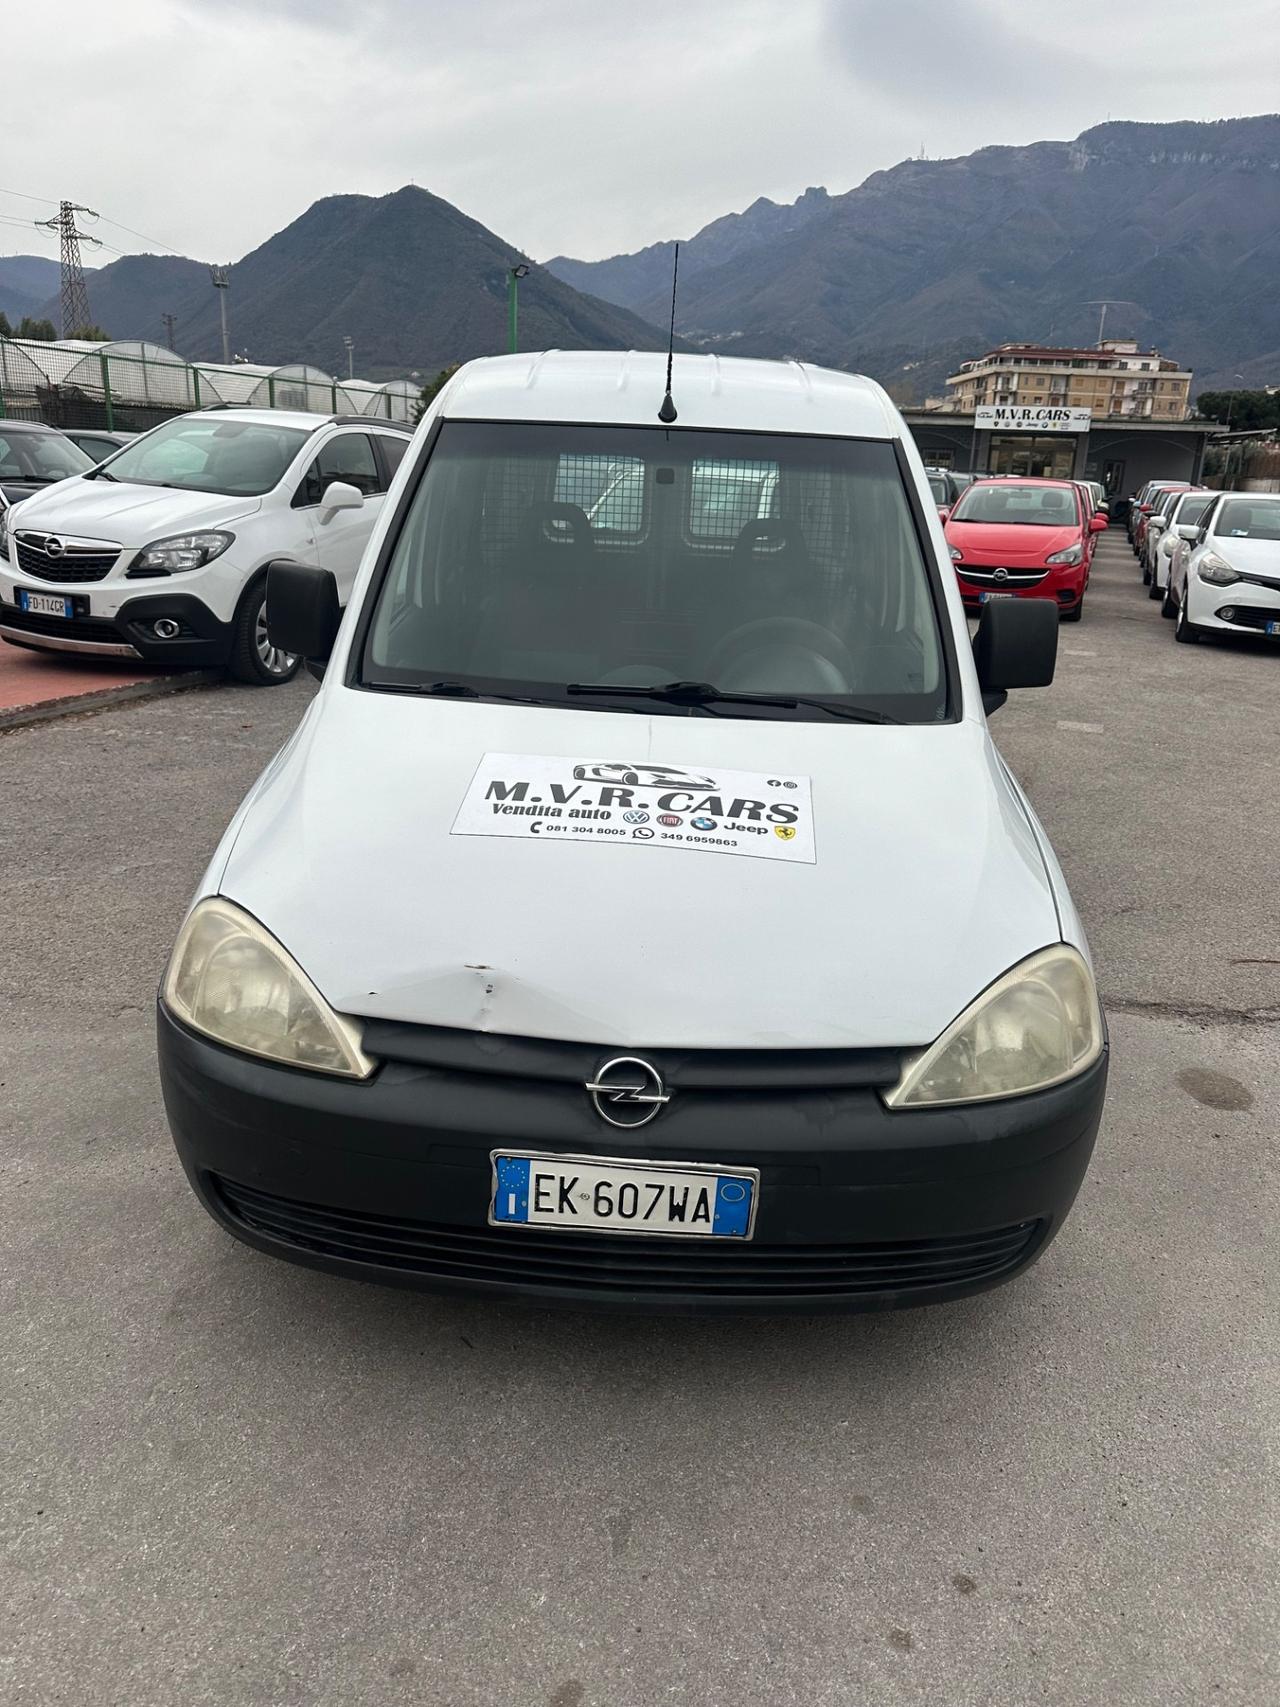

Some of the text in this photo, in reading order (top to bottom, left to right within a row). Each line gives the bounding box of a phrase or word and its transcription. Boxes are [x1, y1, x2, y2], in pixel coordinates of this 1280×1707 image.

[492, 803, 612, 820] Vendita auto
[723, 822, 768, 835] Jeep
[661, 832, 683, 840] 349
[686, 835, 737, 846] 6959863
